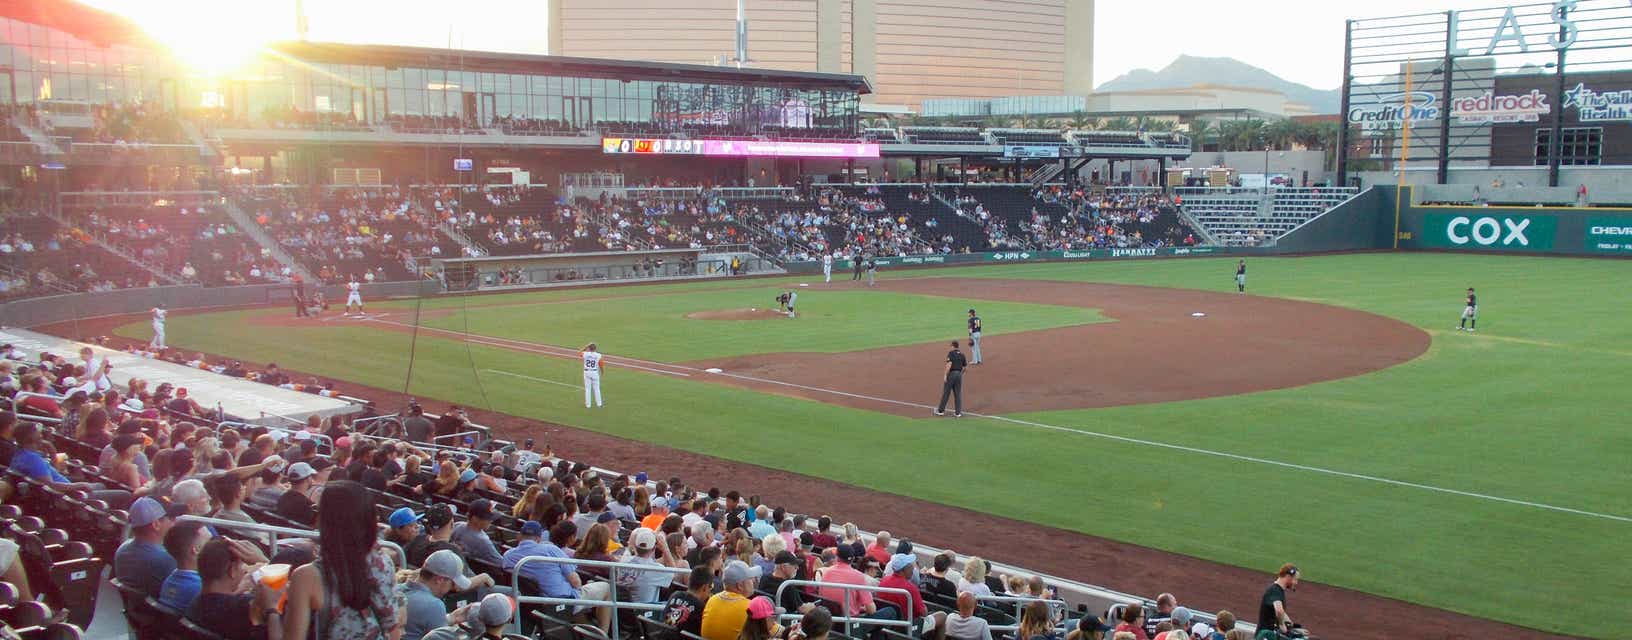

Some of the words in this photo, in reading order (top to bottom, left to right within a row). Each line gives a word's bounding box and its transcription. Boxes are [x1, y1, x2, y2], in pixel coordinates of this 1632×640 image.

[1449, 0, 1578, 56] LAS
[1454, 95, 1490, 112] red
[1495, 91, 1546, 110] rock
[1582, 107, 1627, 119] Health
[1447, 216, 1531, 246] COX
[585, 359, 596, 368] 28
